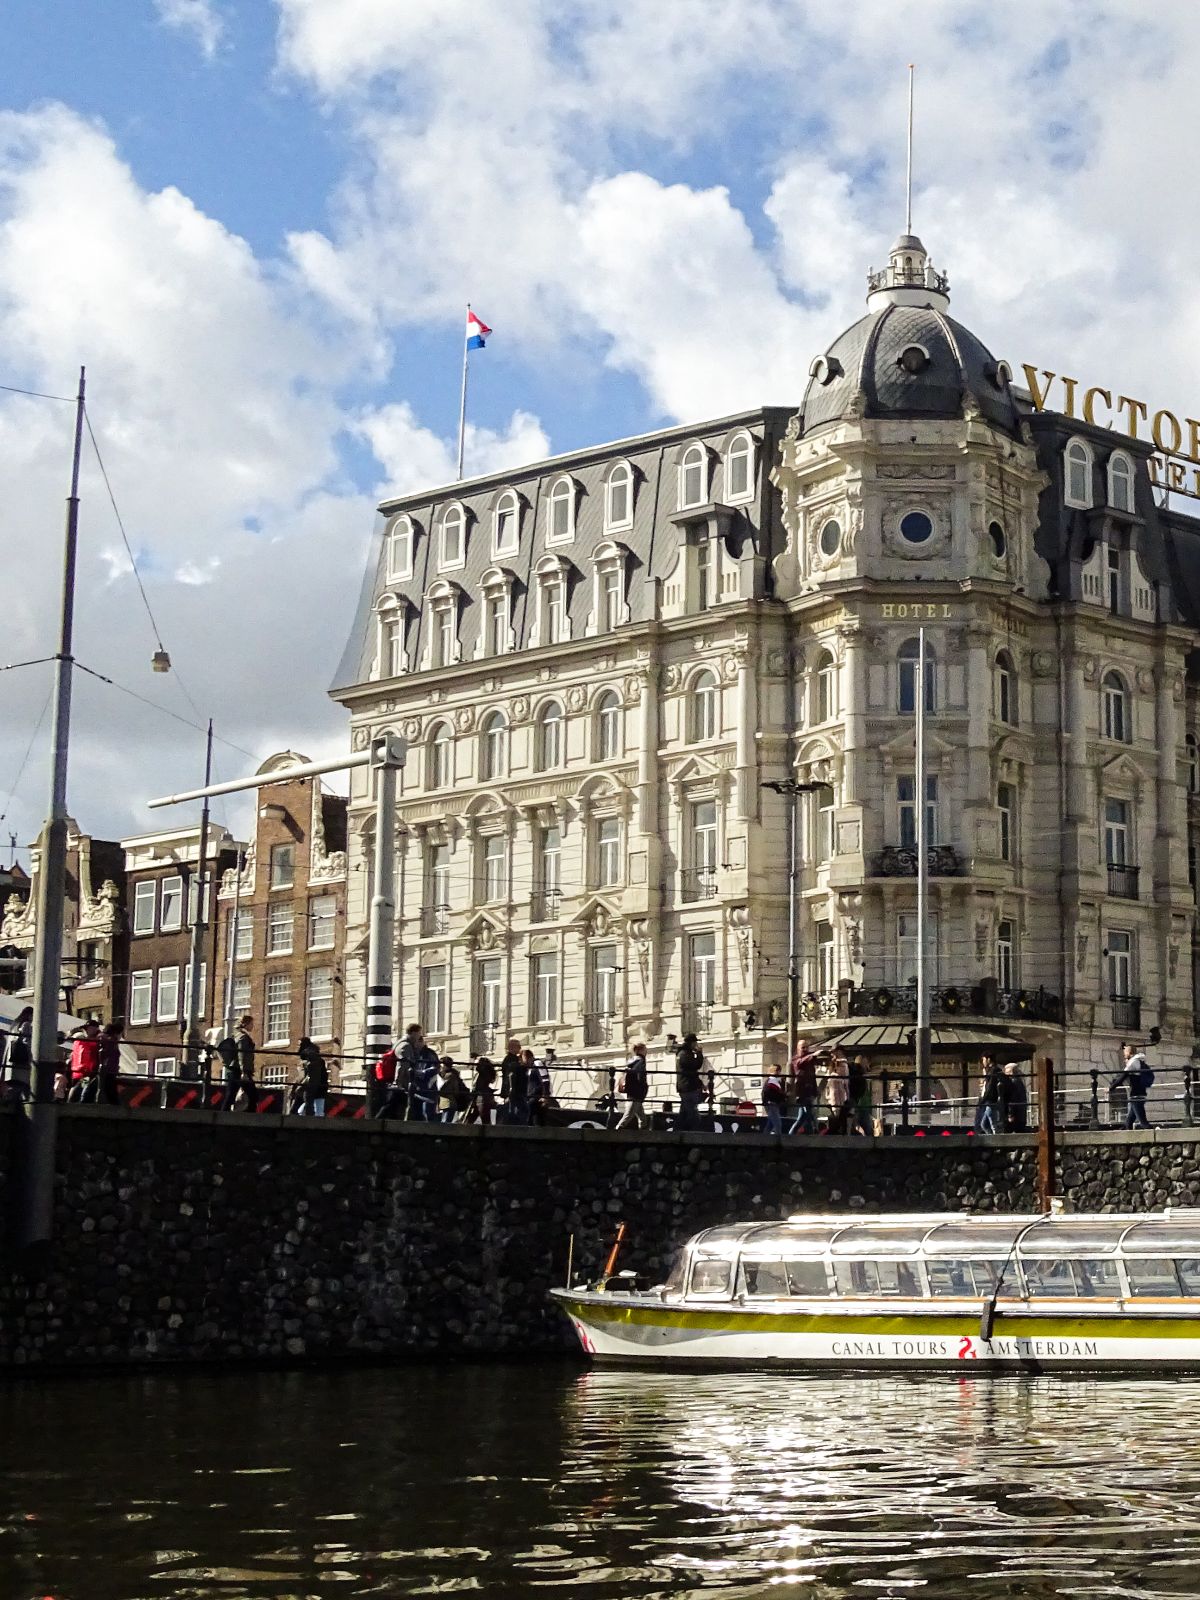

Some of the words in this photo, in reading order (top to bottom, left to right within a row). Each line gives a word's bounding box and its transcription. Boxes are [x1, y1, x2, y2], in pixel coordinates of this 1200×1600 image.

[881, 603, 952, 618] HOTEL
[831, 1341, 885, 1355] CANAL
[892, 1341, 947, 1355] TOURS
[986, 1341, 1098, 1356] AMSTERDAM
